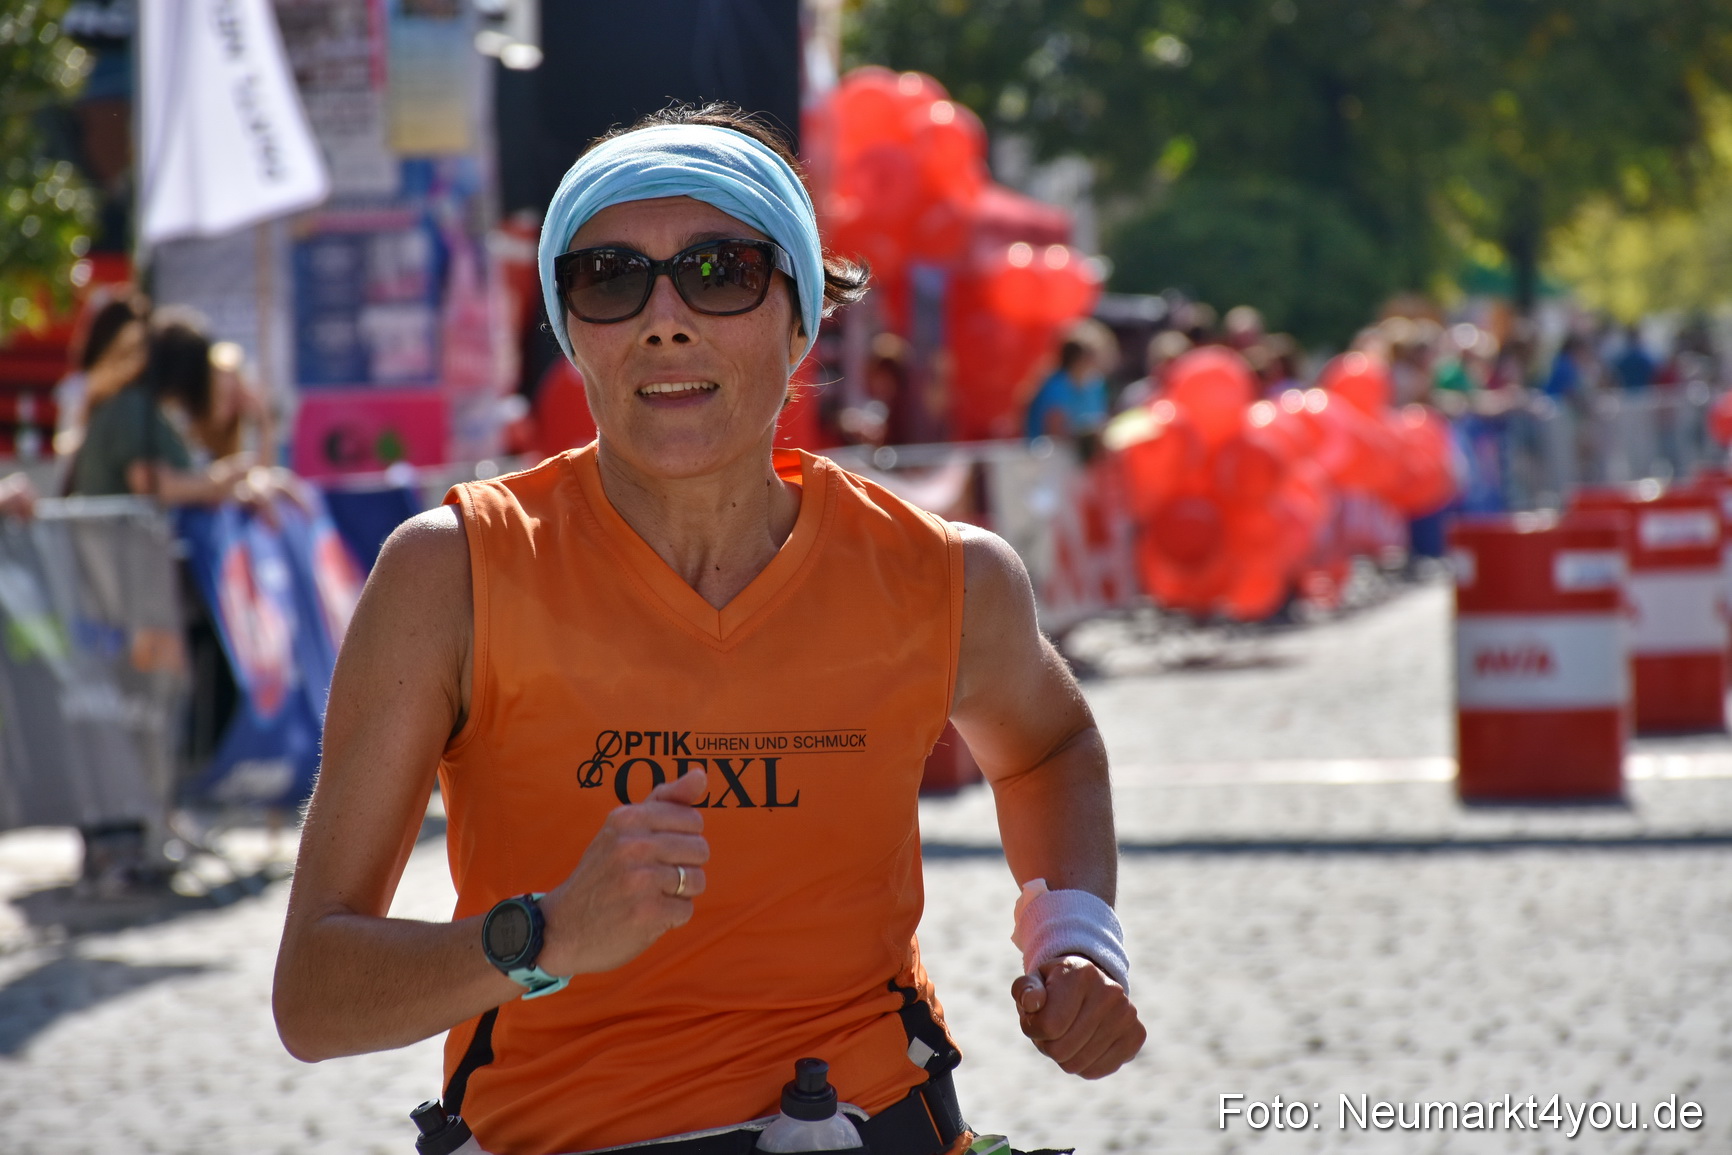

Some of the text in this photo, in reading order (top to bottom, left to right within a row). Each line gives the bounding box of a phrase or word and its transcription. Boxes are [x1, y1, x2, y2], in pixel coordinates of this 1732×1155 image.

[695, 737, 749, 751] UHREN
[755, 736, 788, 750] UND
[793, 733, 867, 749] SCHMUCK
